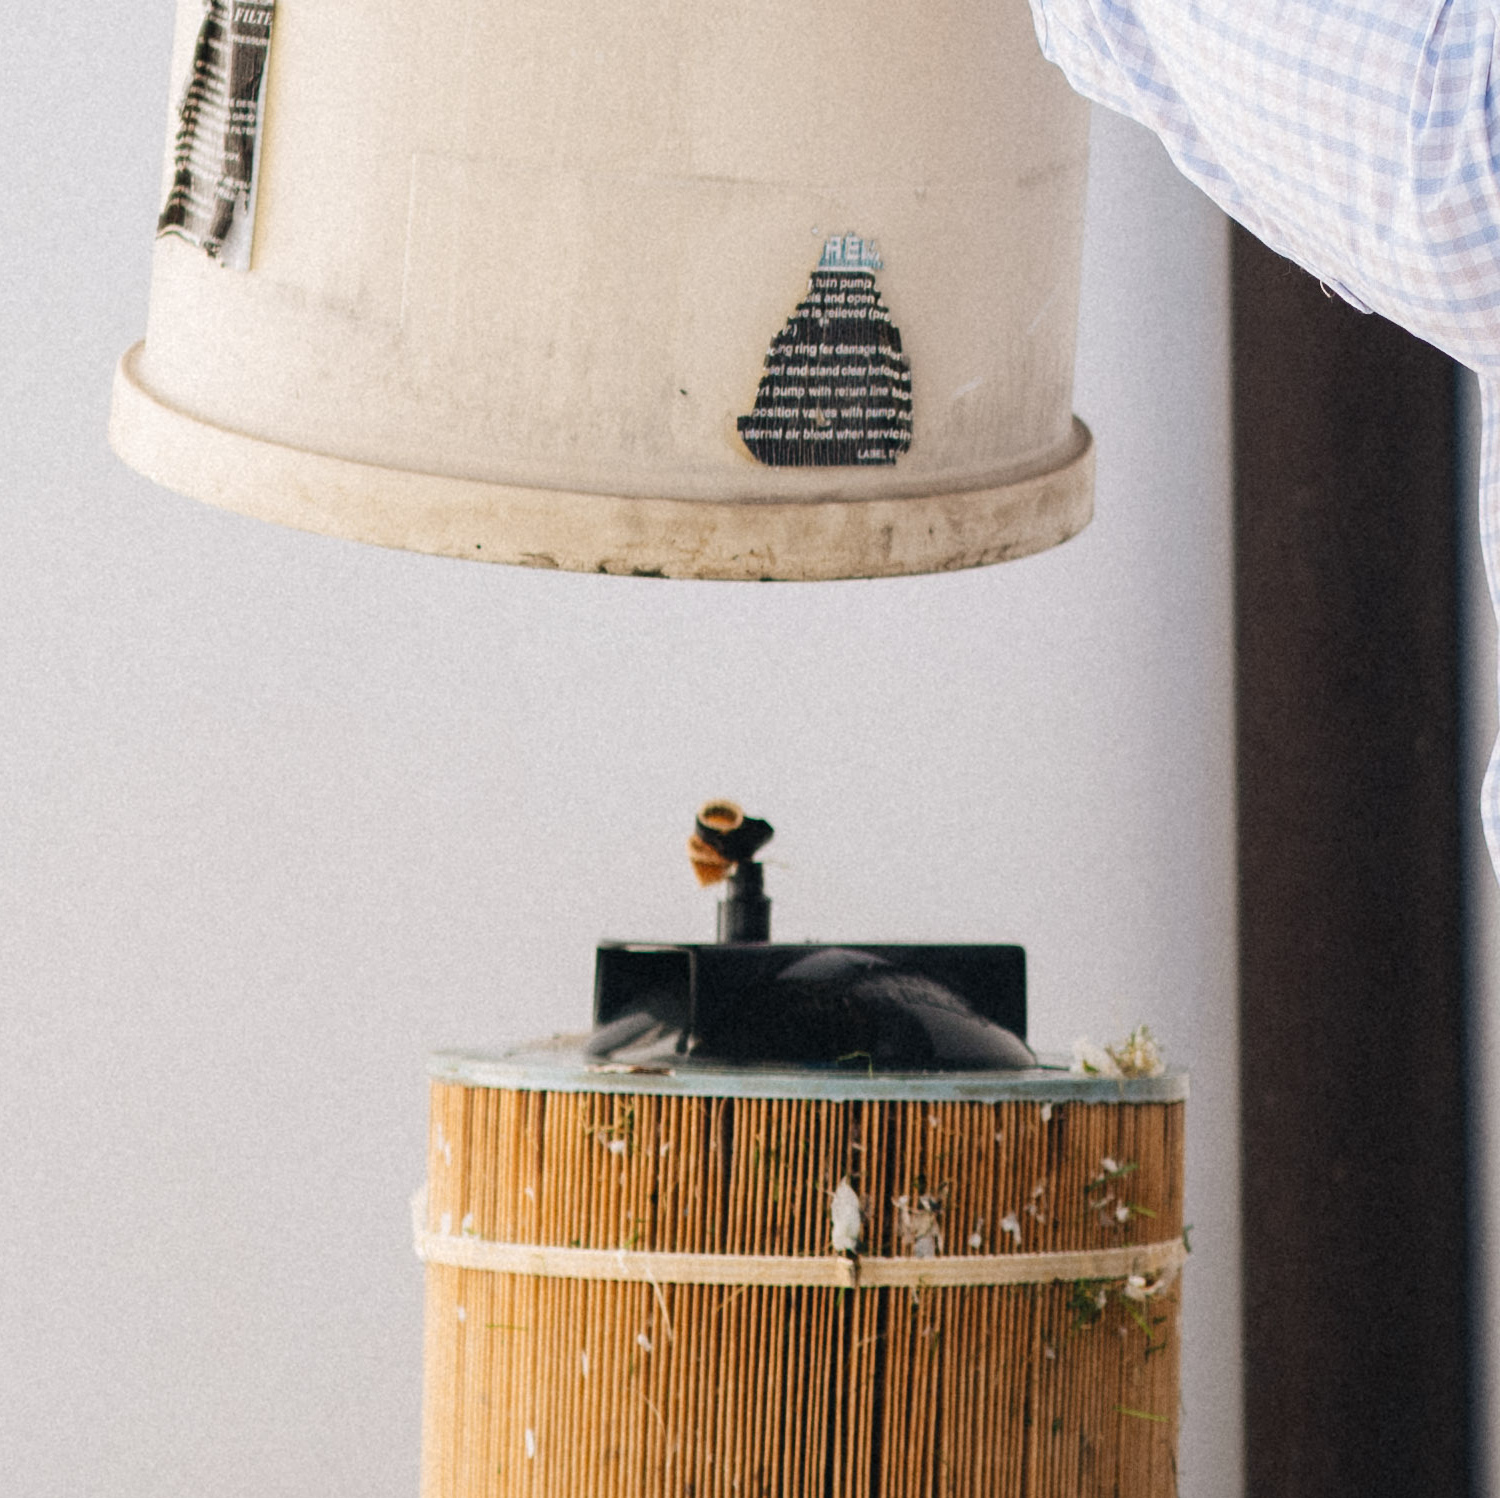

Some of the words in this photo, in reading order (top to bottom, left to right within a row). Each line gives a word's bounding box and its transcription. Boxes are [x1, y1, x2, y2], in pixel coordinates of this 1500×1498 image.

[840, 279, 873, 290] pump
[824, 293, 845, 304] and
[847, 294, 875, 305] open
[835, 343, 877, 357] damage
[786, 364, 808, 377] and
[809, 364, 840, 377] stand
[772, 386, 805, 399] pump
[808, 385, 832, 397] with
[840, 406, 863, 418] with
[865, 407, 897, 420] pump
